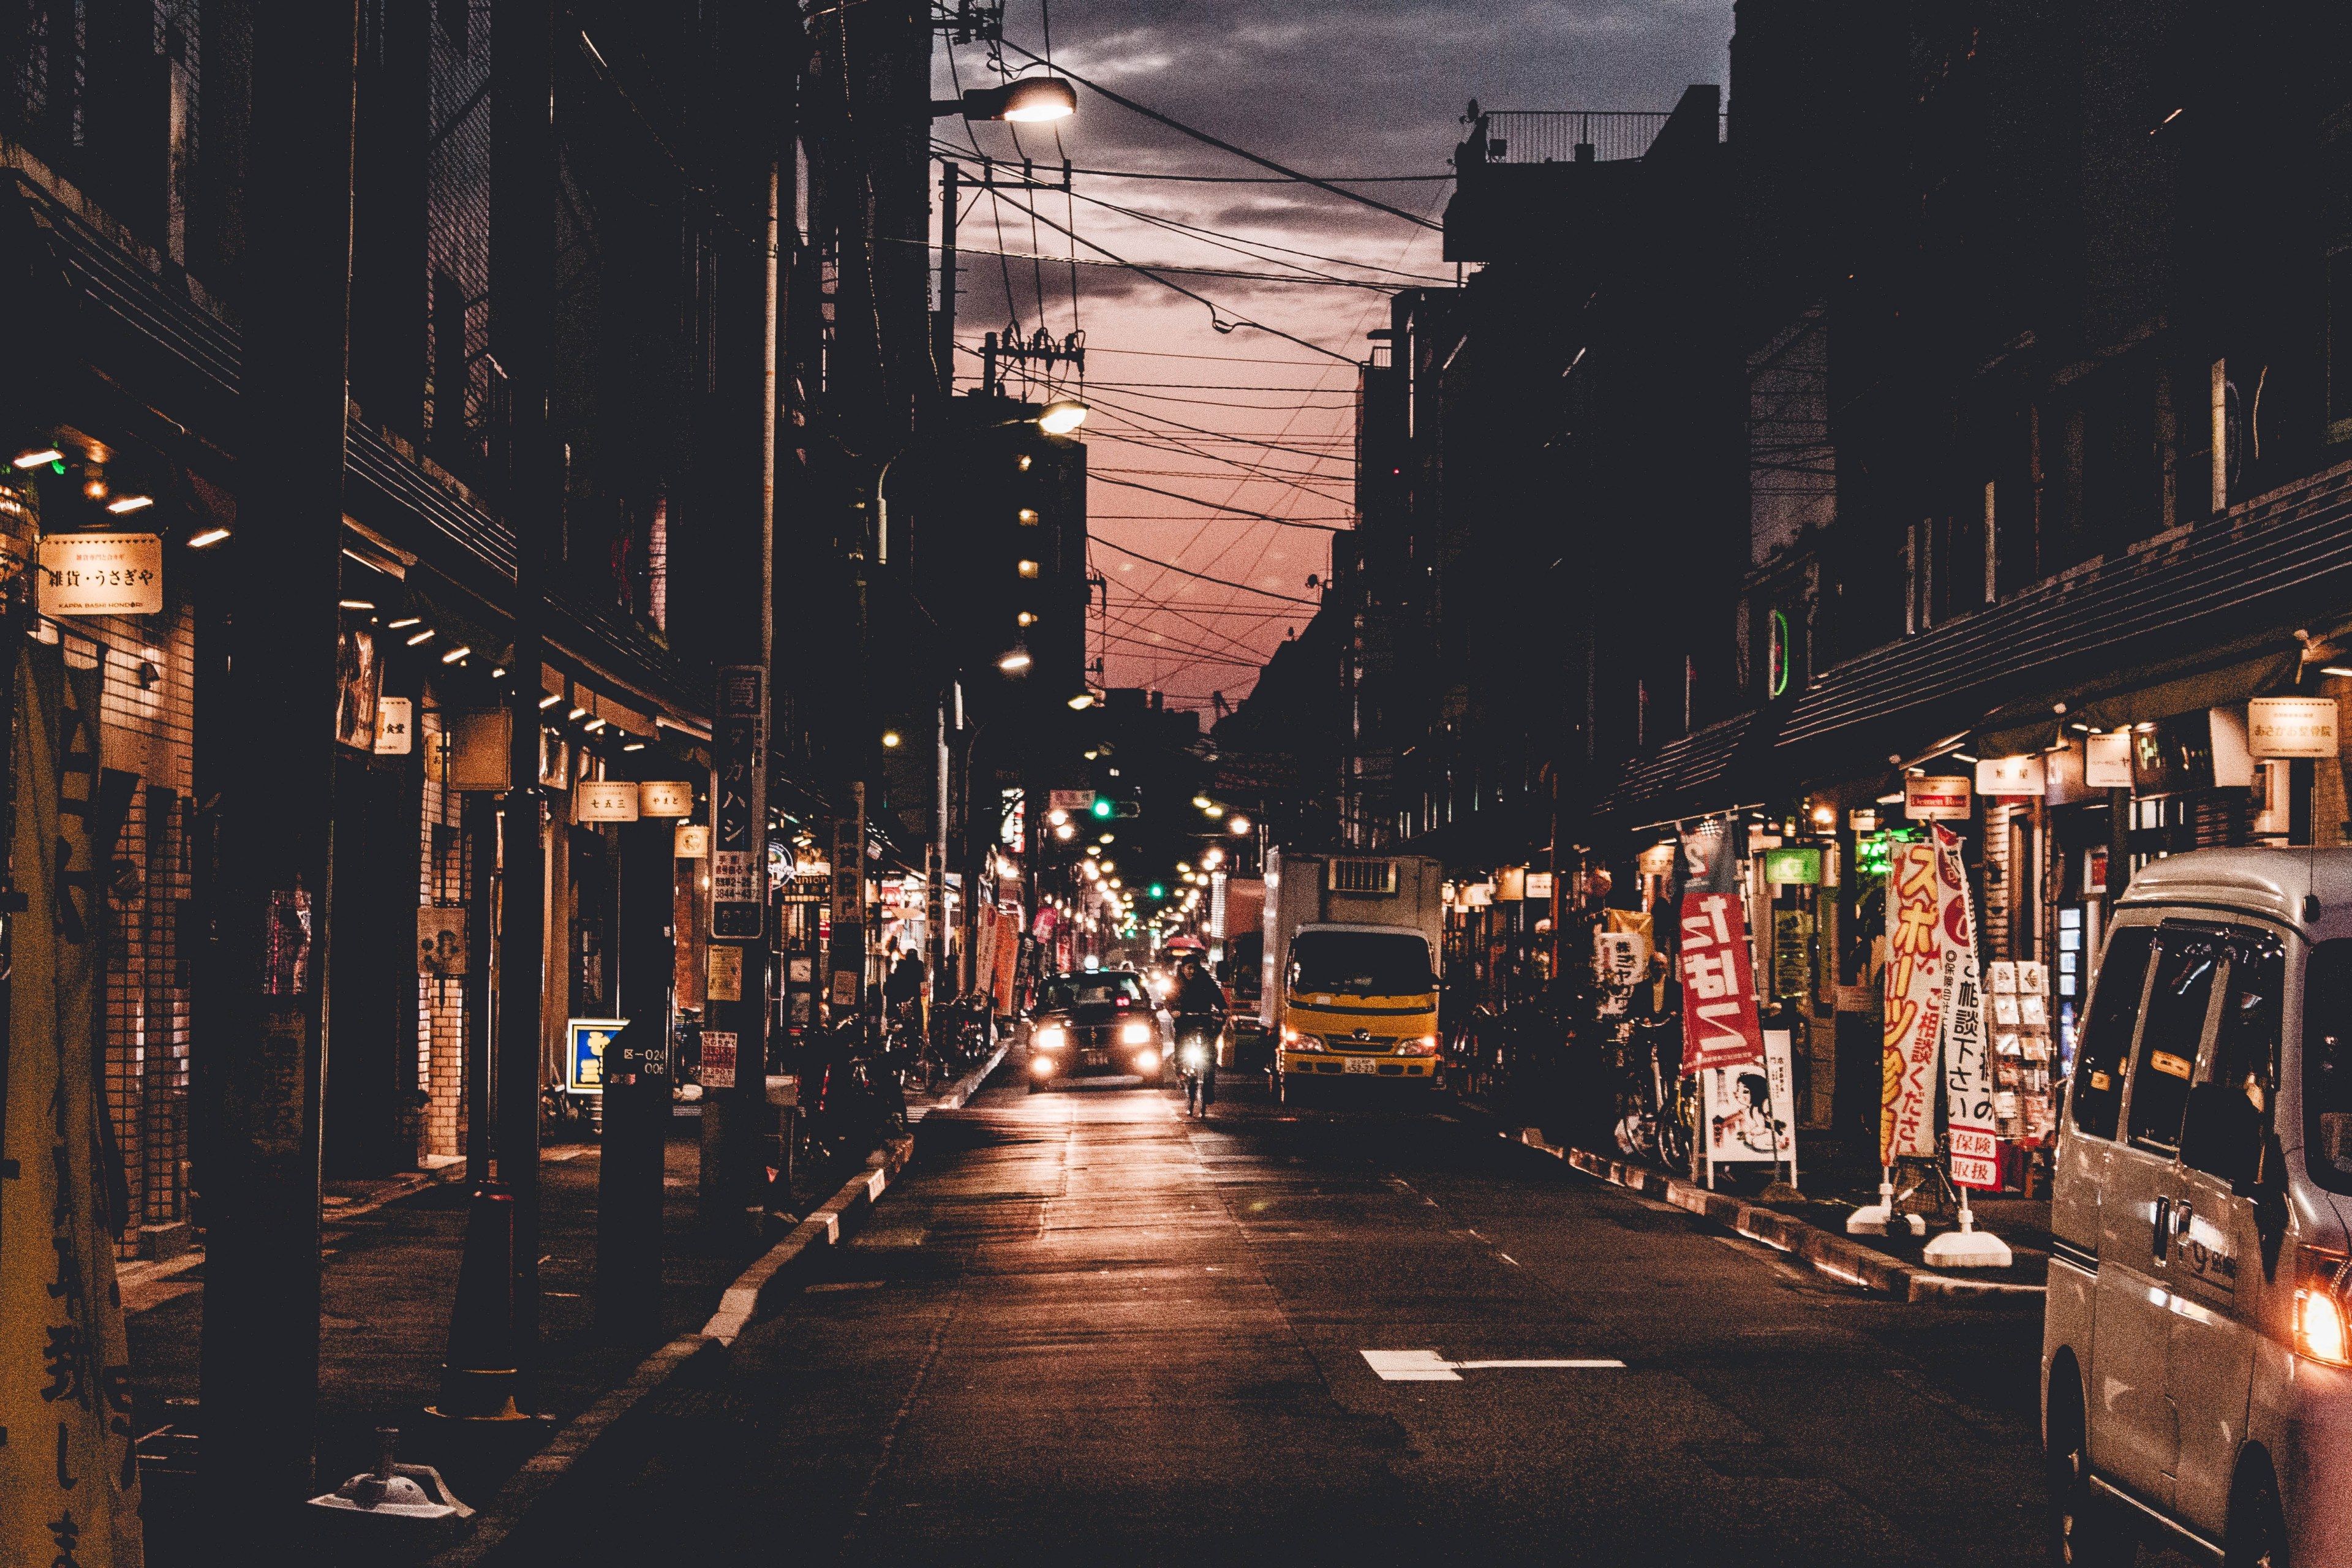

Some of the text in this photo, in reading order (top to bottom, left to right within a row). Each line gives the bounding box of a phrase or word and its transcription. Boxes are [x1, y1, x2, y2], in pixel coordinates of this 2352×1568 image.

[48, 568, 154, 587] 雑貨・うさぎや
[383, 723, 405, 734] 食堂
[591, 799, 625, 809] 七五三
[794, 876, 828, 885] union
